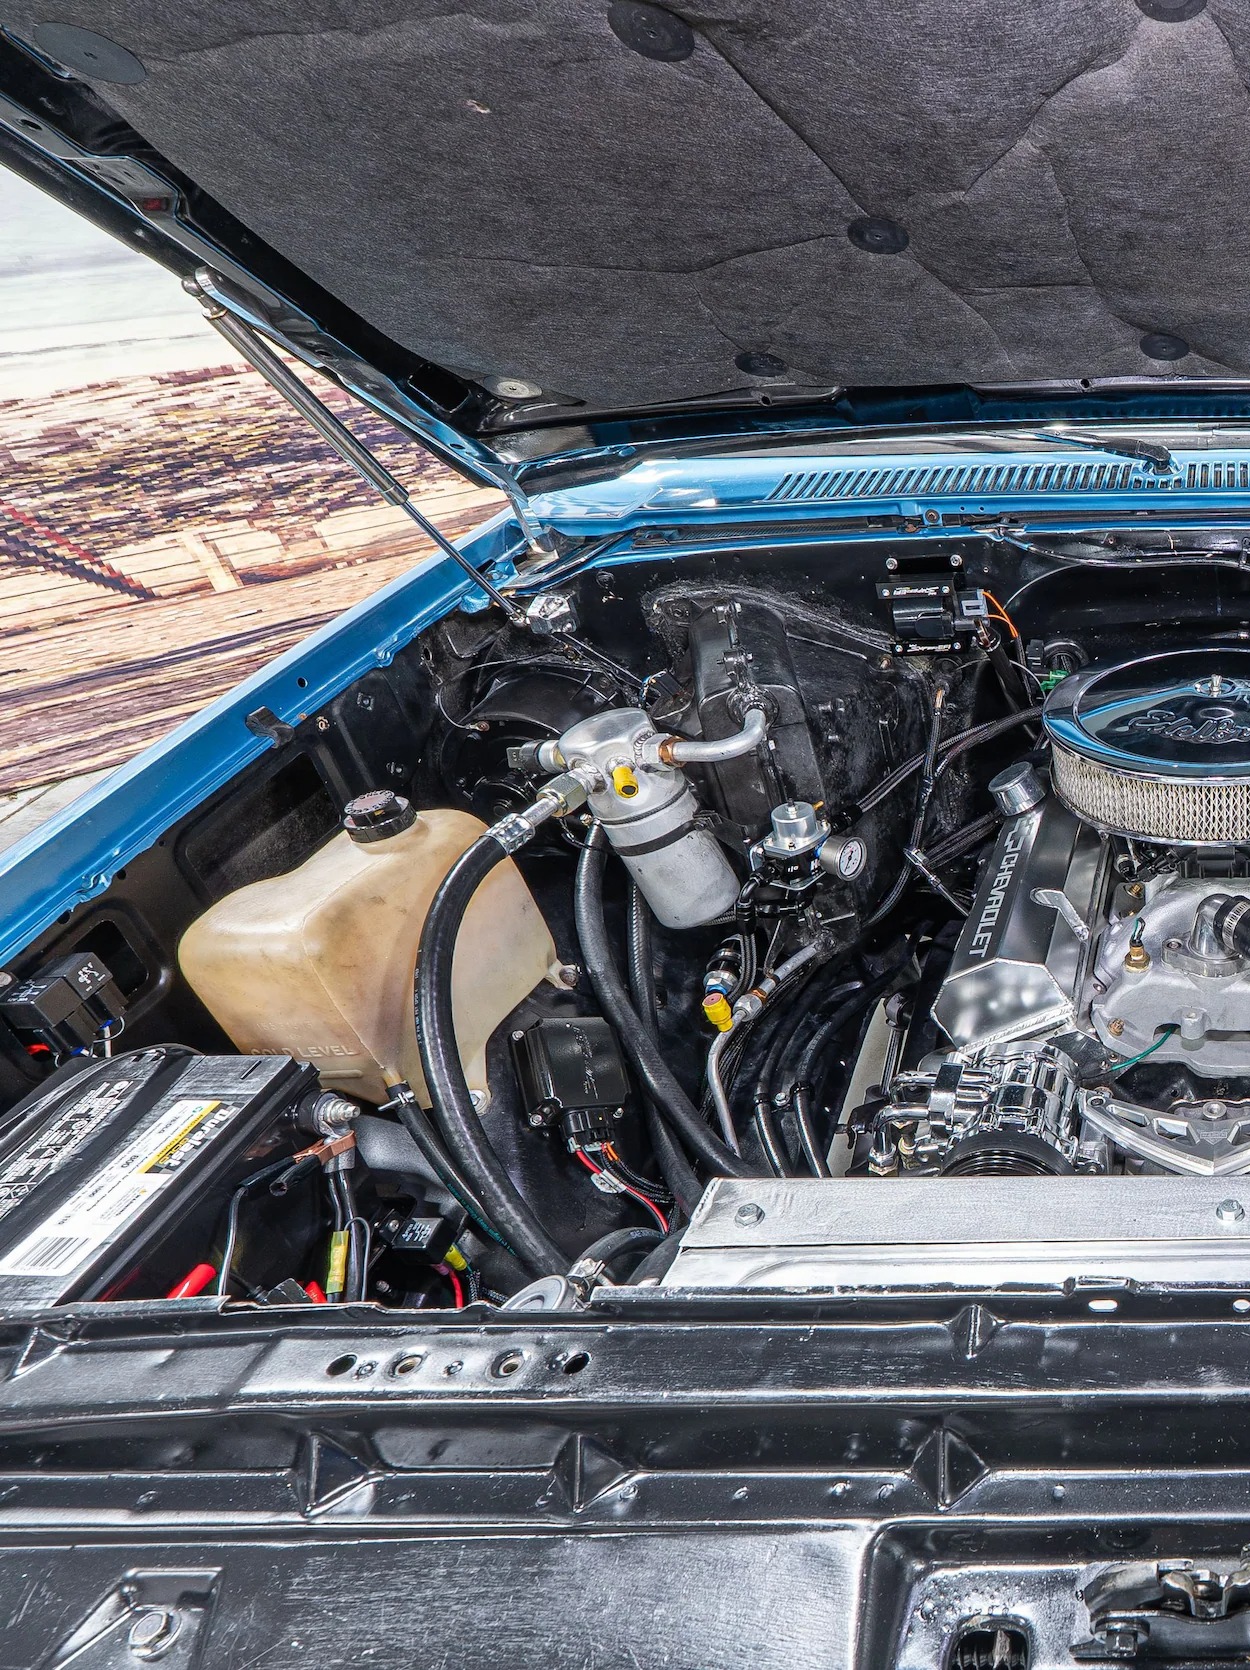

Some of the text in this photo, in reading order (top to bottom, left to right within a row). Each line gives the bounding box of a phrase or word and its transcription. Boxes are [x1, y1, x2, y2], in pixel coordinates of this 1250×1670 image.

[969, 853, 1019, 958] CHEVROLET
[297, 1045, 358, 1058] LEVEL
[162, 1105, 237, 1167] Duralast
